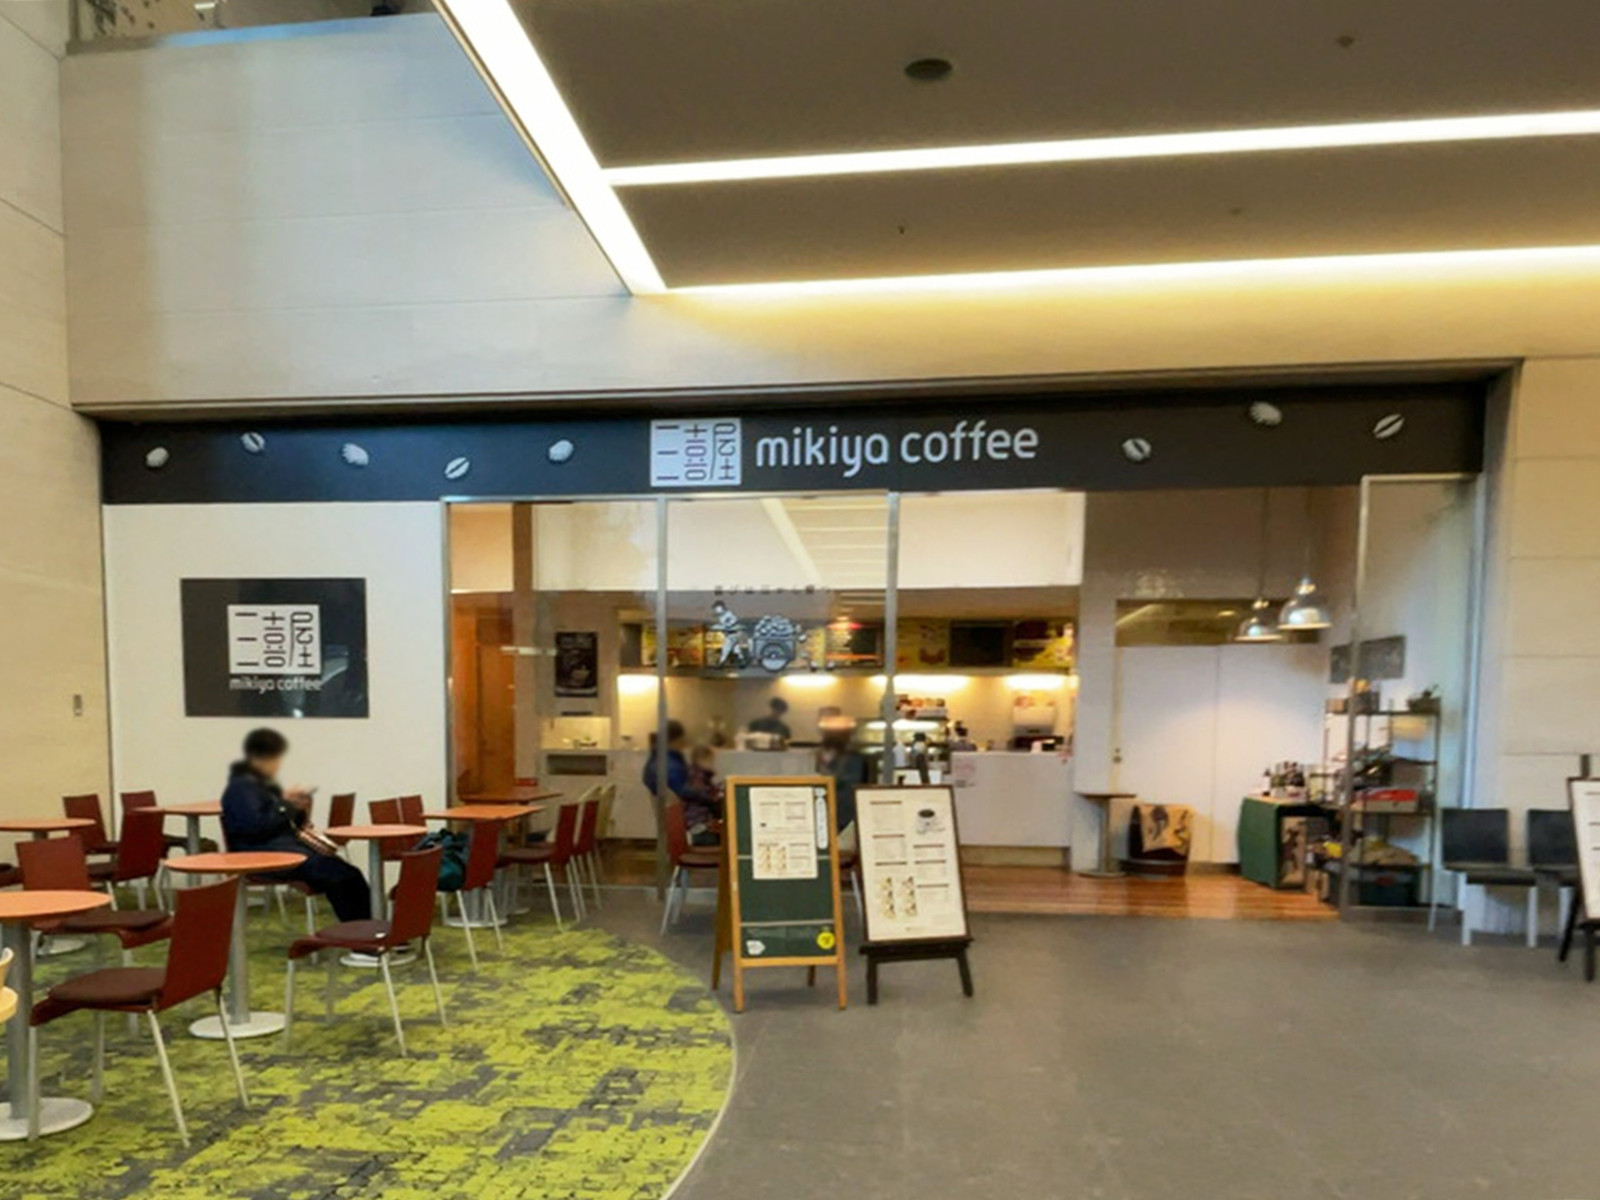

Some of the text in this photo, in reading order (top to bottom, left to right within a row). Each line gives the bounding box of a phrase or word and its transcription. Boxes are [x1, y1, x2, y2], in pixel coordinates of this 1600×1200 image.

[755, 420, 1039, 478] mikiya coffee
[277, 676, 321, 691] coffee
